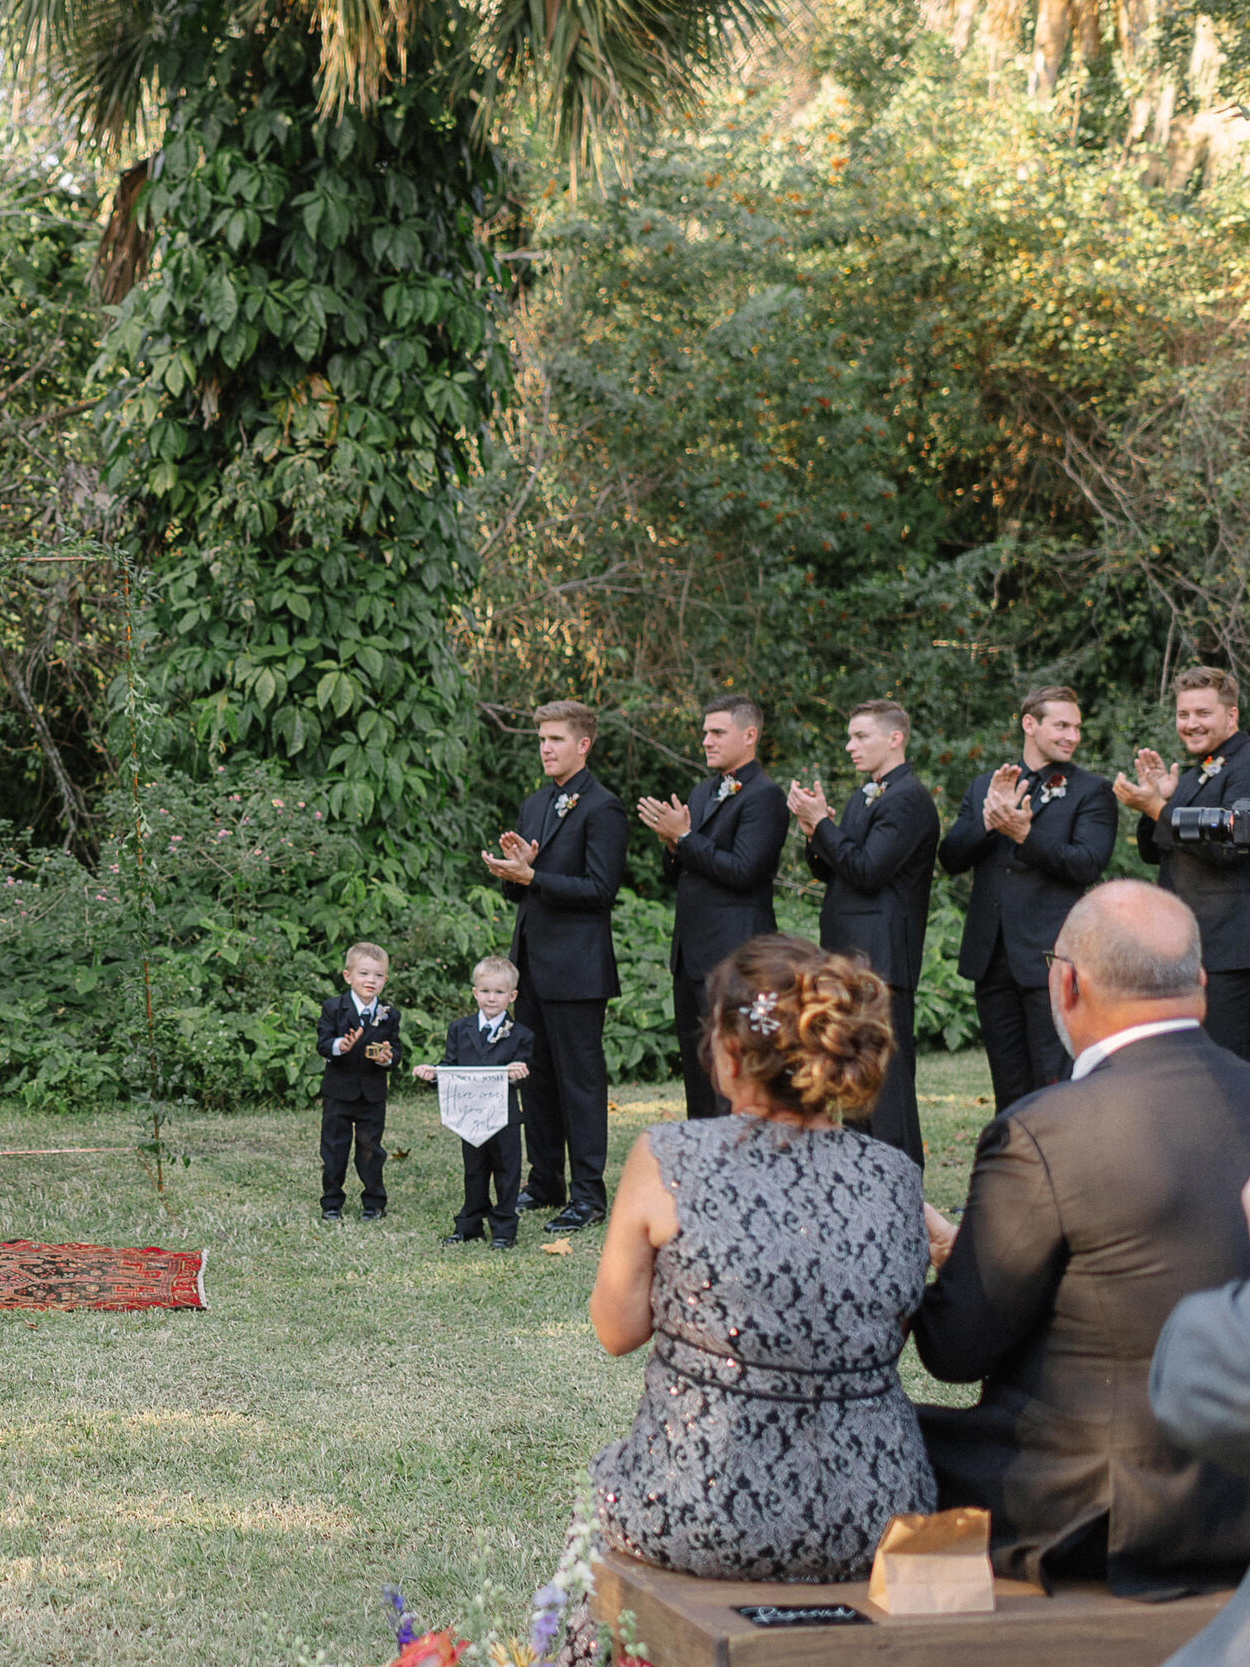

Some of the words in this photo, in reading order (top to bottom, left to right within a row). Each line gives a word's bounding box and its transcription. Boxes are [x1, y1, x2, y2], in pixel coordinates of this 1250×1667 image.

[482, 1074, 504, 1083] JOSH
[442, 1079, 475, 1117] Here
[456, 1104, 487, 1128] your
[469, 1104, 502, 1140] girl
